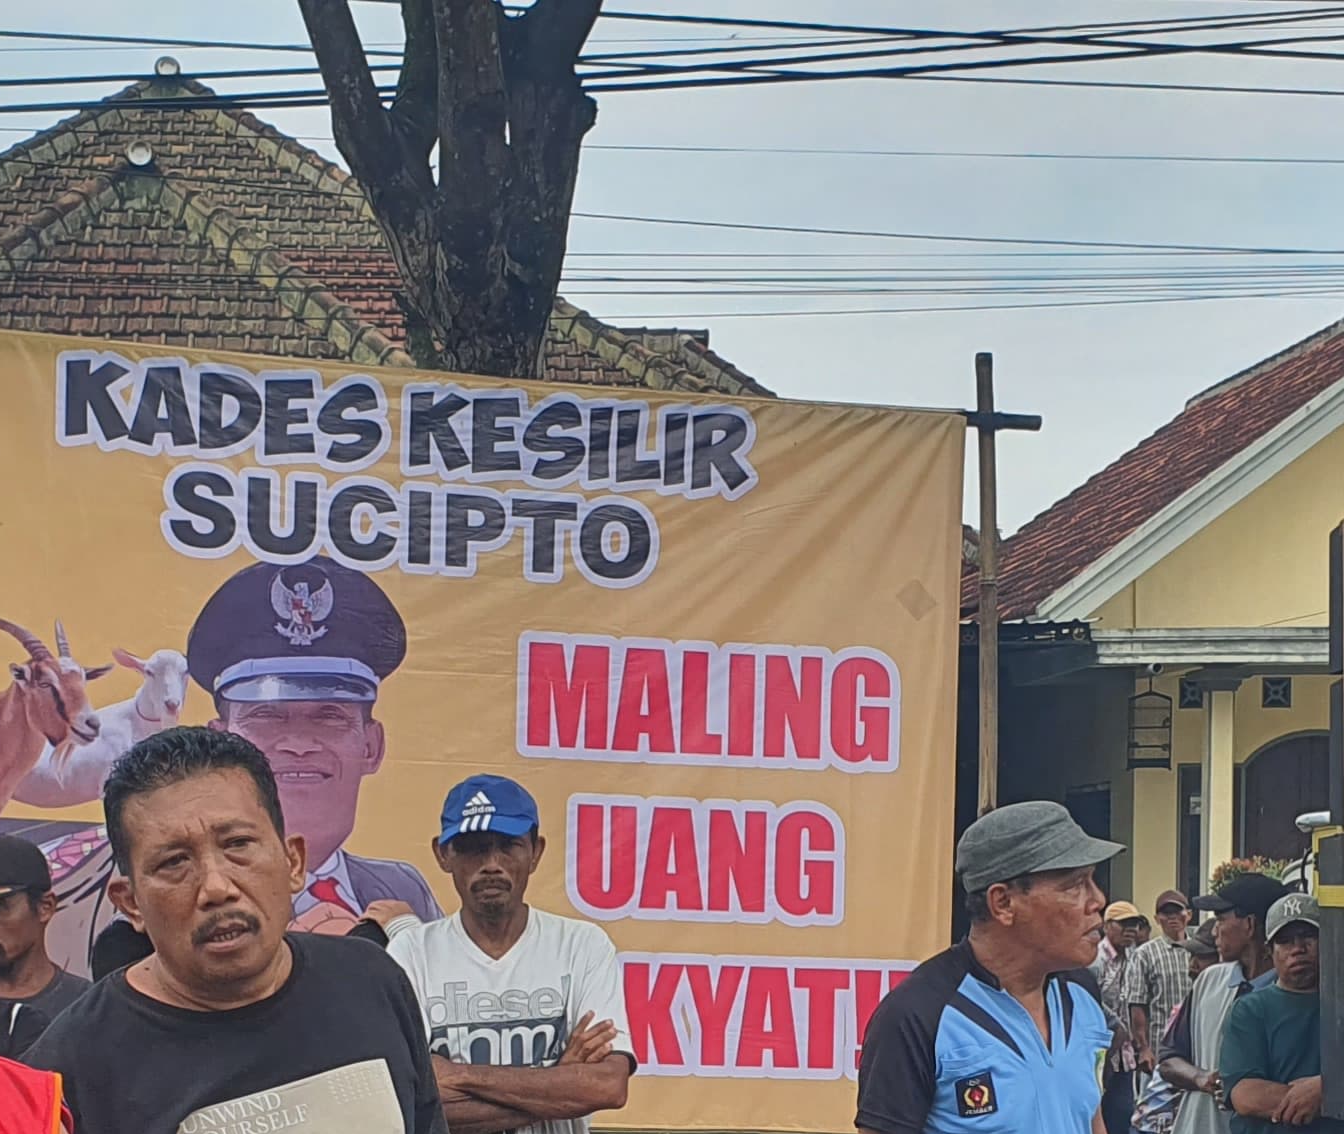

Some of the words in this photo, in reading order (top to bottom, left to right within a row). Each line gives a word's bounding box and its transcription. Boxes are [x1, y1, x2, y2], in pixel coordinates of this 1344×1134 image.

[60, 354, 385, 468] KADES
[405, 387, 754, 496] KESILIR
[166, 467, 656, 583] SUCIPTO
[523, 640, 894, 766] MALING
[573, 800, 838, 918] UANG
[620, 960, 913, 1072] KYAT!
[180, 1091, 282, 1134] UNWIND
